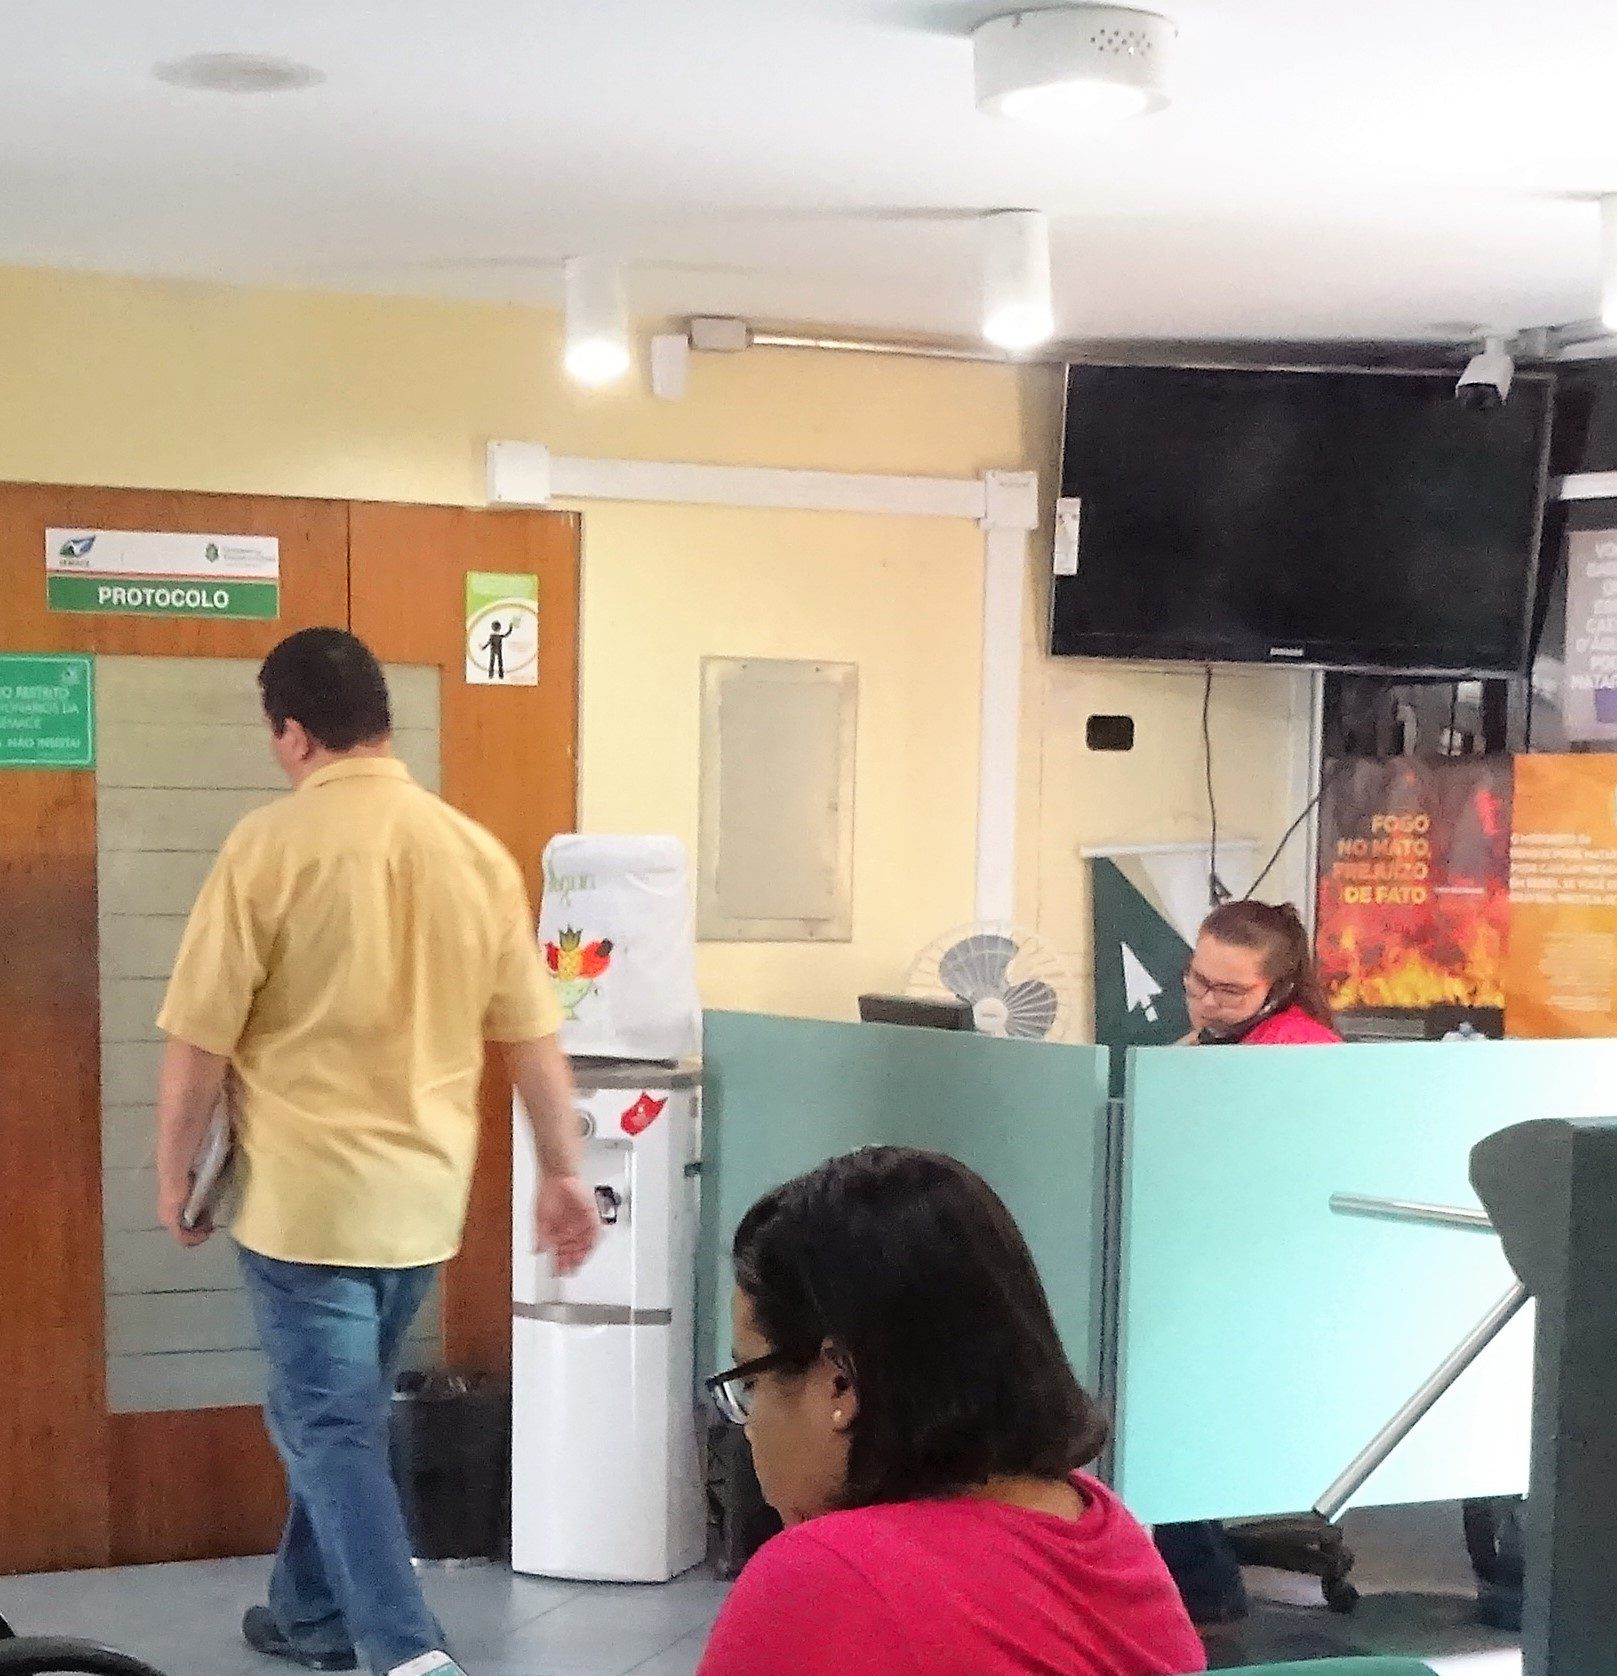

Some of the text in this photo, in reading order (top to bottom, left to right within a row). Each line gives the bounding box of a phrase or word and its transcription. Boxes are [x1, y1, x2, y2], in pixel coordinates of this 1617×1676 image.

[98, 586, 229, 609] PROTOCOLO
[1371, 814, 1430, 834] FOGO
[1344, 886, 1427, 905] DE FATO
